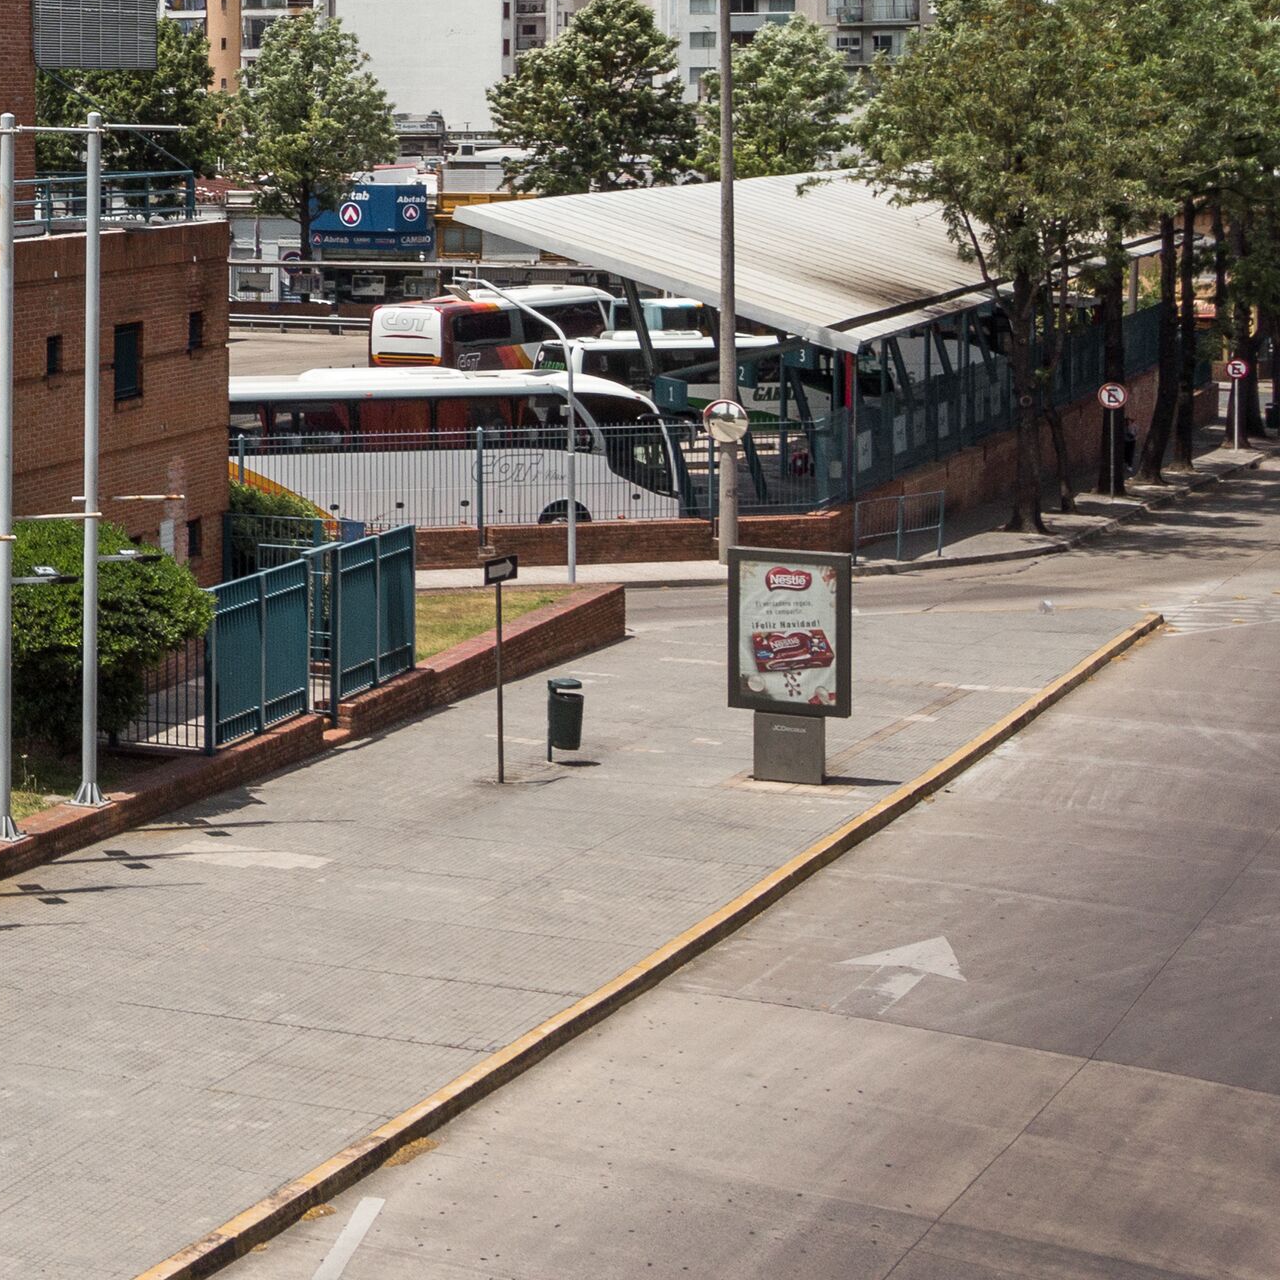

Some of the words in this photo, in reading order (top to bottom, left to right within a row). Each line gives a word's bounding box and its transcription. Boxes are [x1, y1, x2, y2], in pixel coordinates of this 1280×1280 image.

[380, 311, 432, 332] COT
[799, 349, 805, 362] 3
[739, 366, 745, 381] 2
[668, 386, 674, 402] 1
[780, 619, 820, 628] Navidad!
